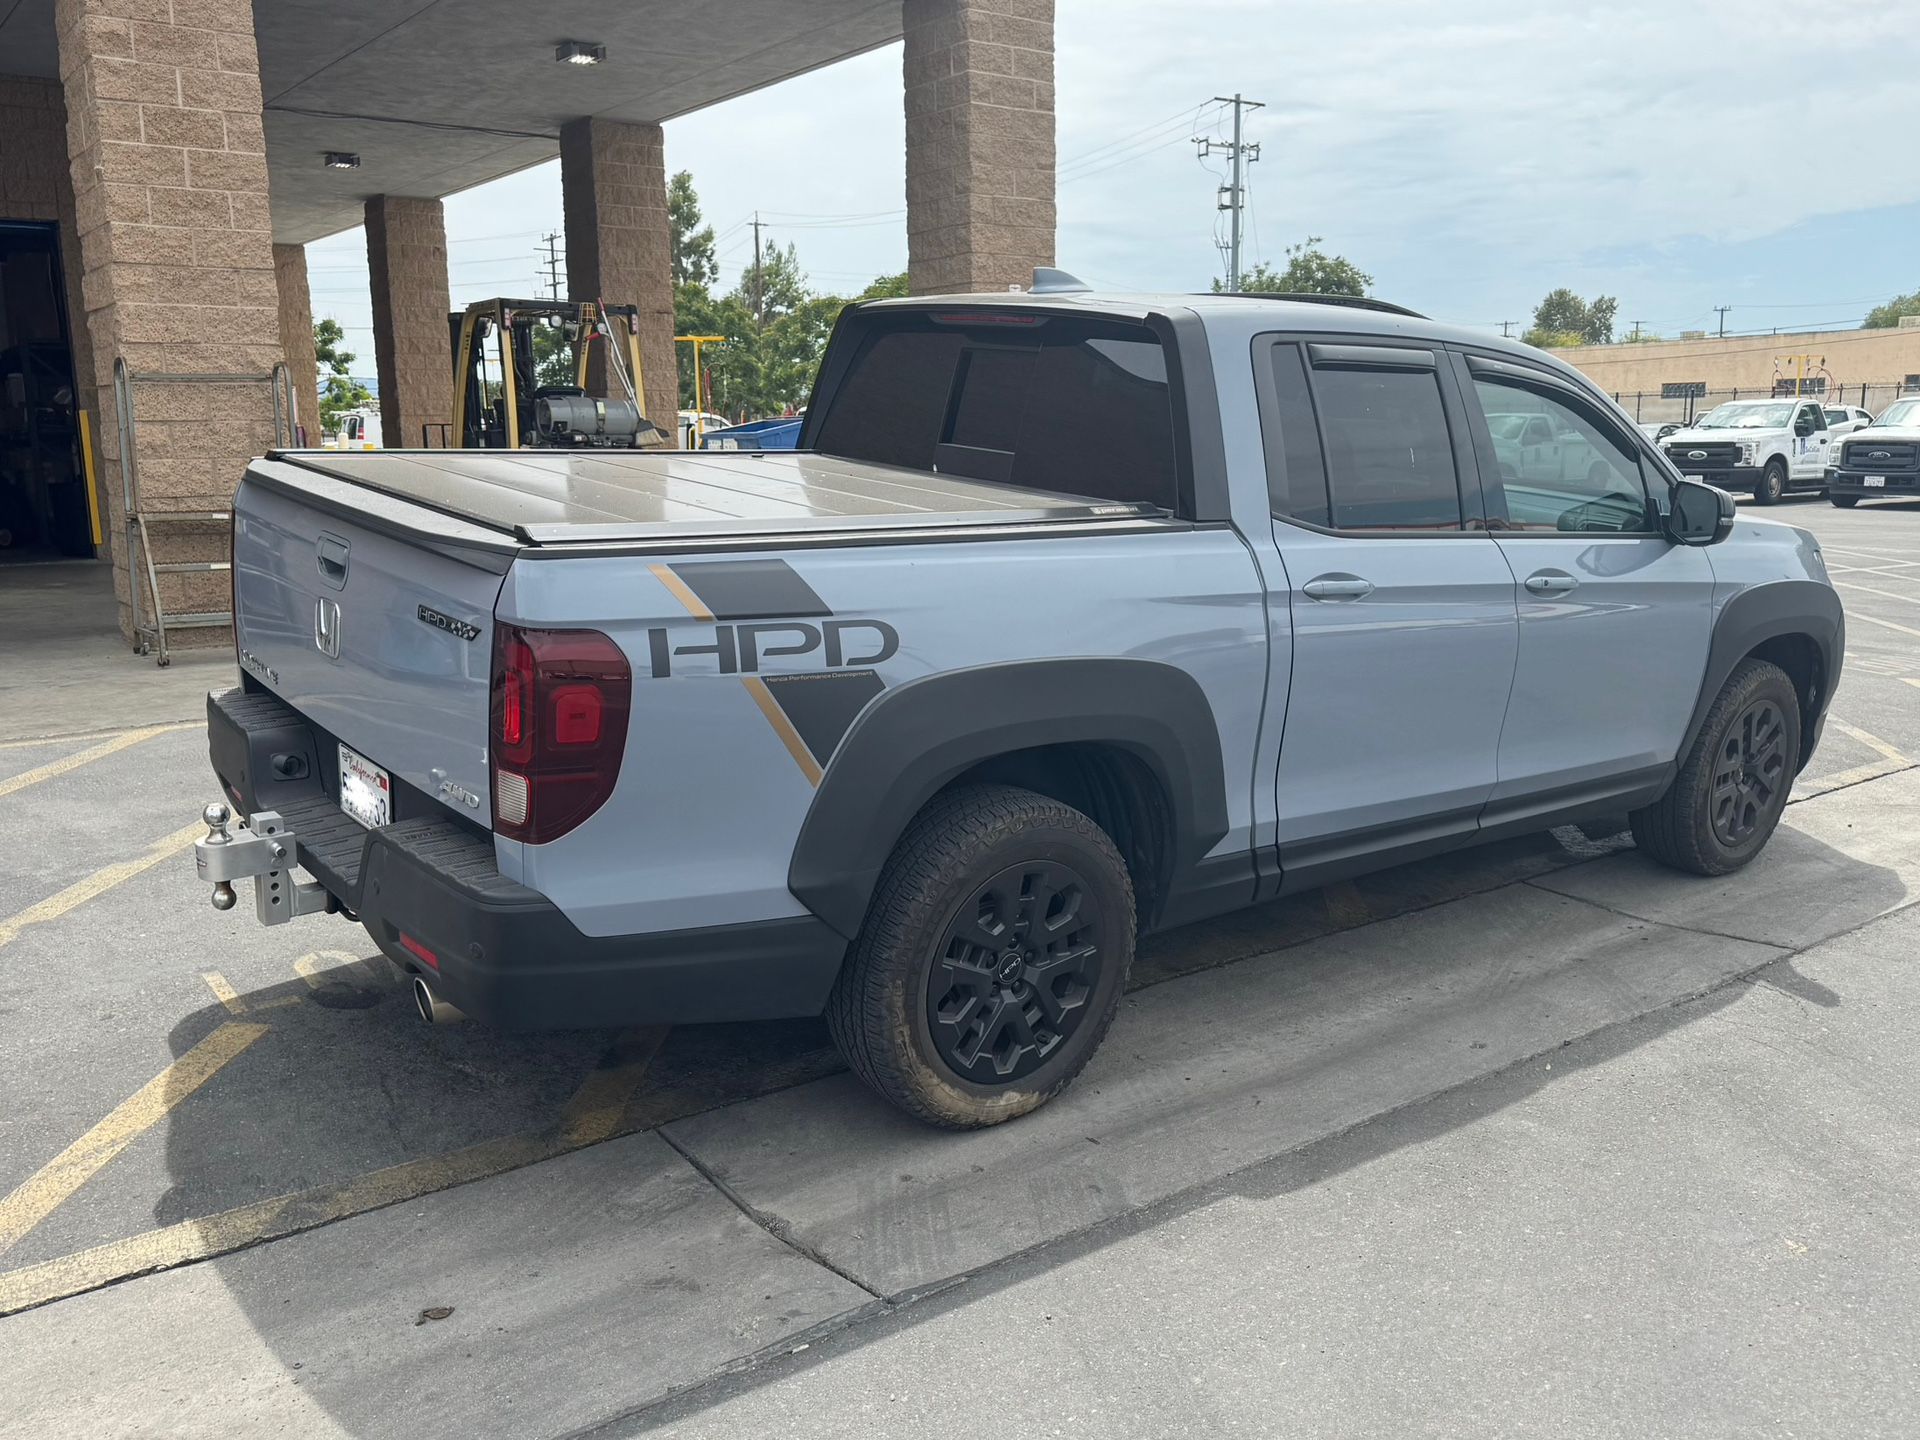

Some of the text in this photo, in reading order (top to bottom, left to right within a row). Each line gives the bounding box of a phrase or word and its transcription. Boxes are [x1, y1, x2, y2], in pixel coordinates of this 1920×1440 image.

[418, 607, 447, 628] HPD
[648, 619, 899, 678] HPD
[788, 673, 831, 681] Performance
